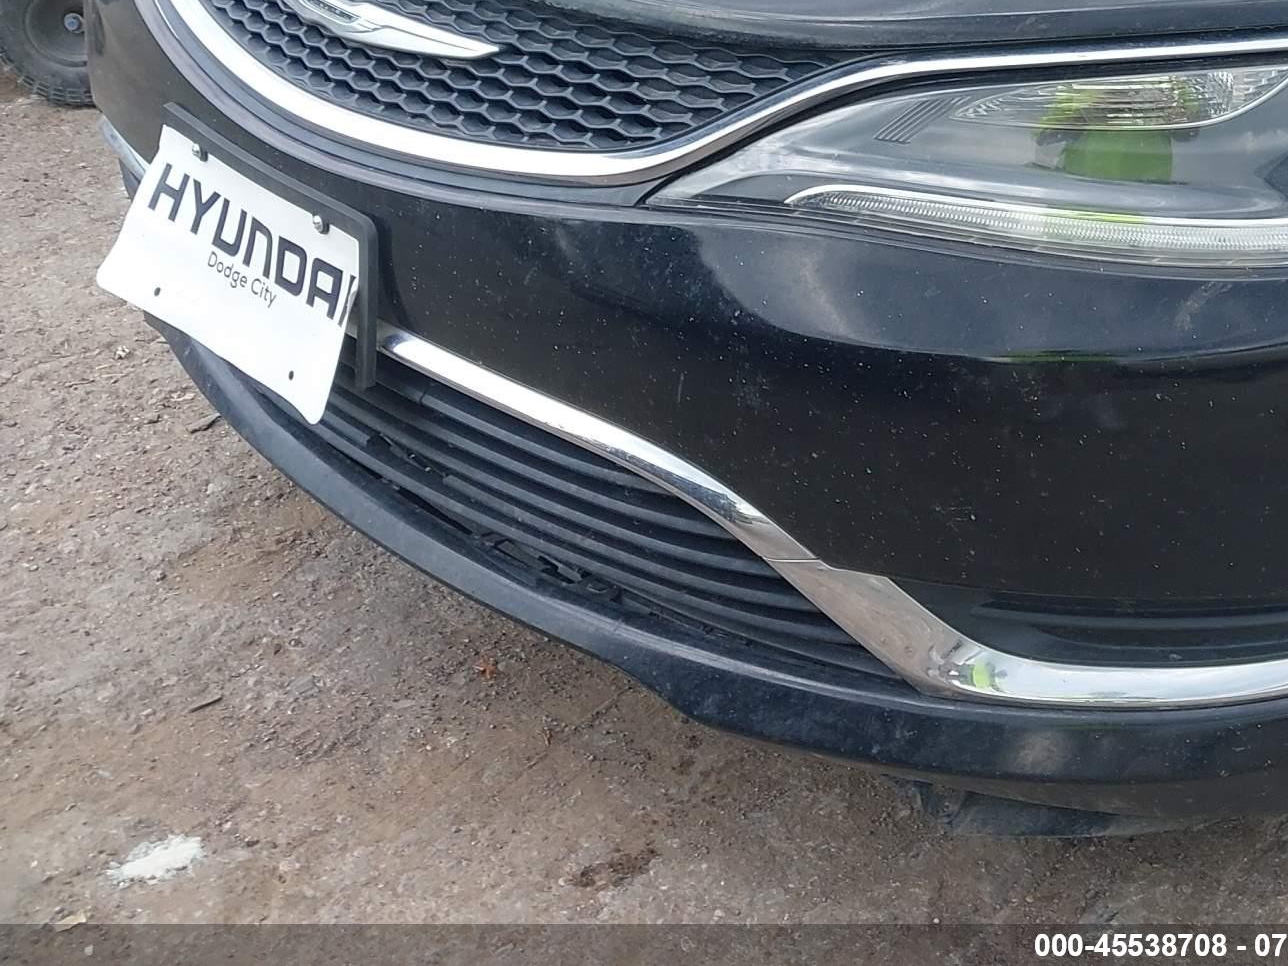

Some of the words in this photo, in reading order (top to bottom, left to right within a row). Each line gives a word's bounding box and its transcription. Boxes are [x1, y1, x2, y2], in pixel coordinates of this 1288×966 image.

[148, 163, 357, 328] HYUNDAI
[207, 251, 248, 289] Dodge
[250, 277, 278, 309] City
